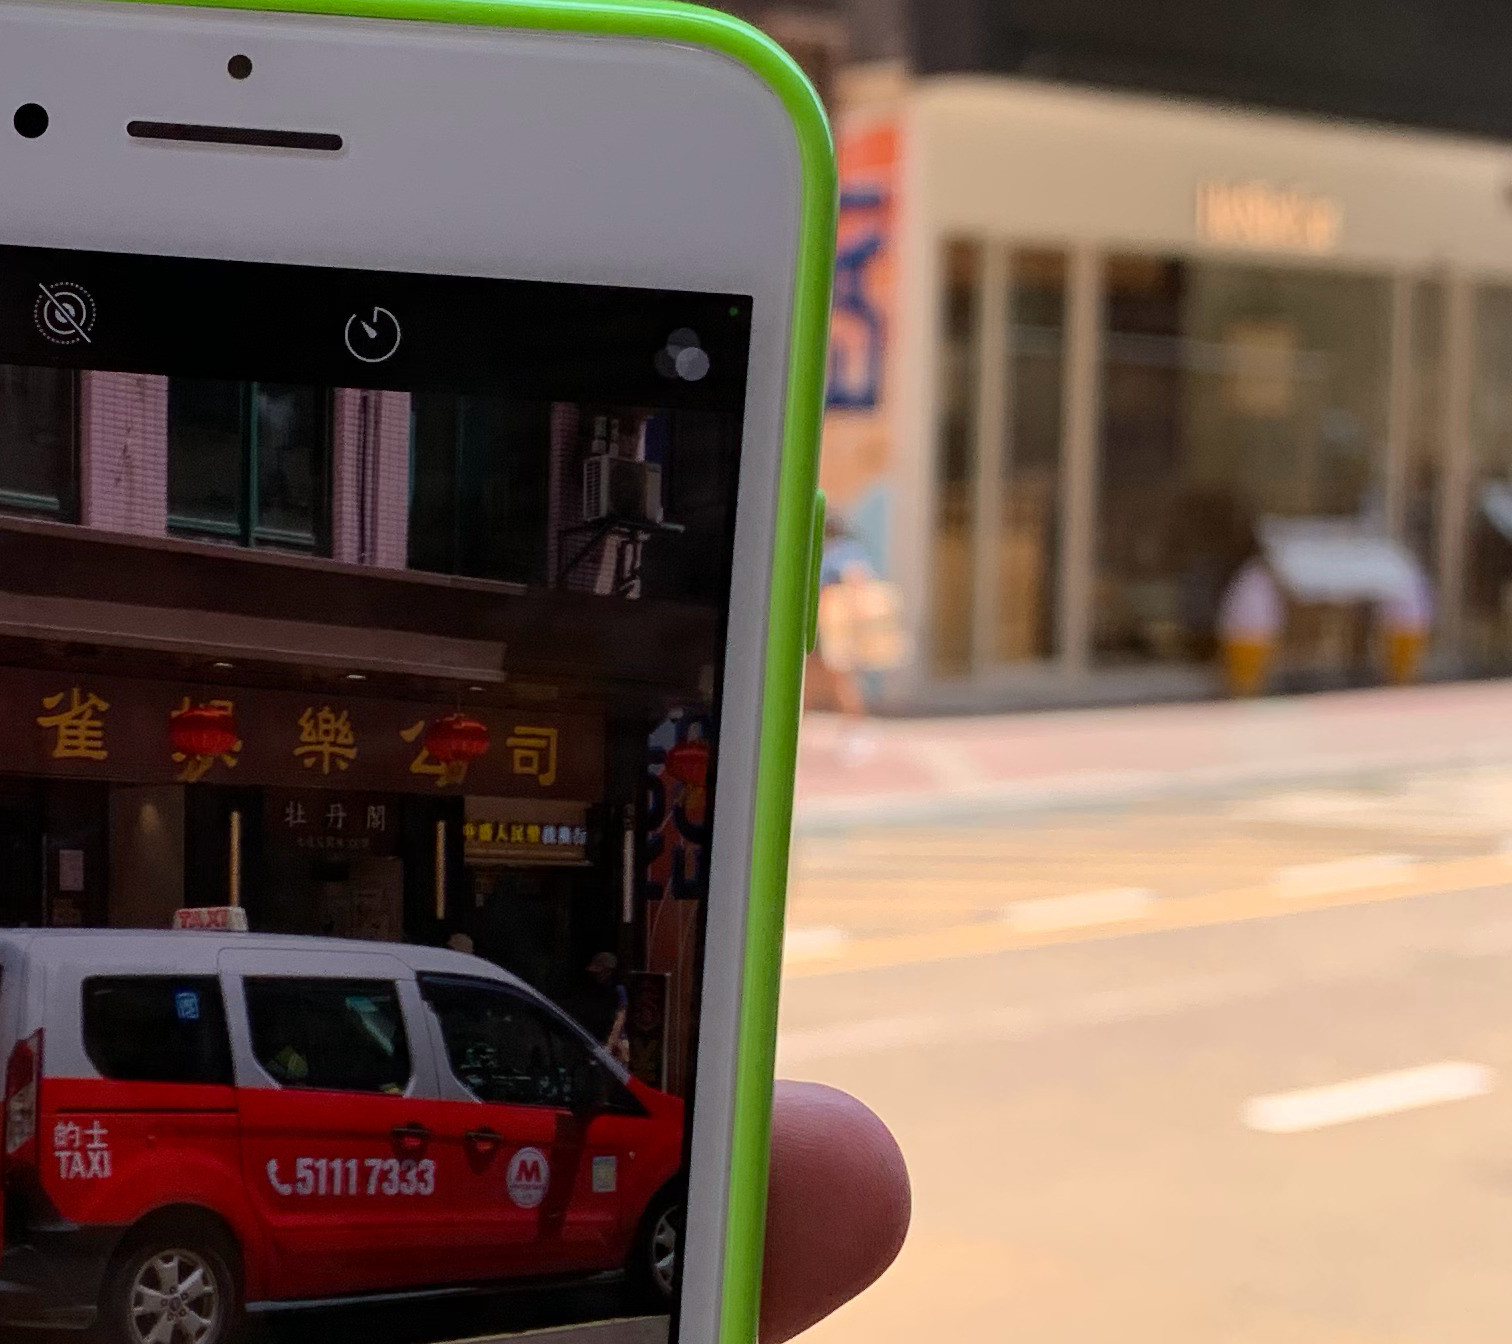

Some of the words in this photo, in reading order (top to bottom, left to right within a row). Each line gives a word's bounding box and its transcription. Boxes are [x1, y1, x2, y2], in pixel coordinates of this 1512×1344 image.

[179, 910, 229, 929] TAXI
[54, 1120, 109, 1148] 的士
[54, 1150, 112, 1179] TAXI
[295, 1157, 358, 1196] 5111
[364, 1158, 435, 1196] 7333
[515, 1159, 541, 1183] M
